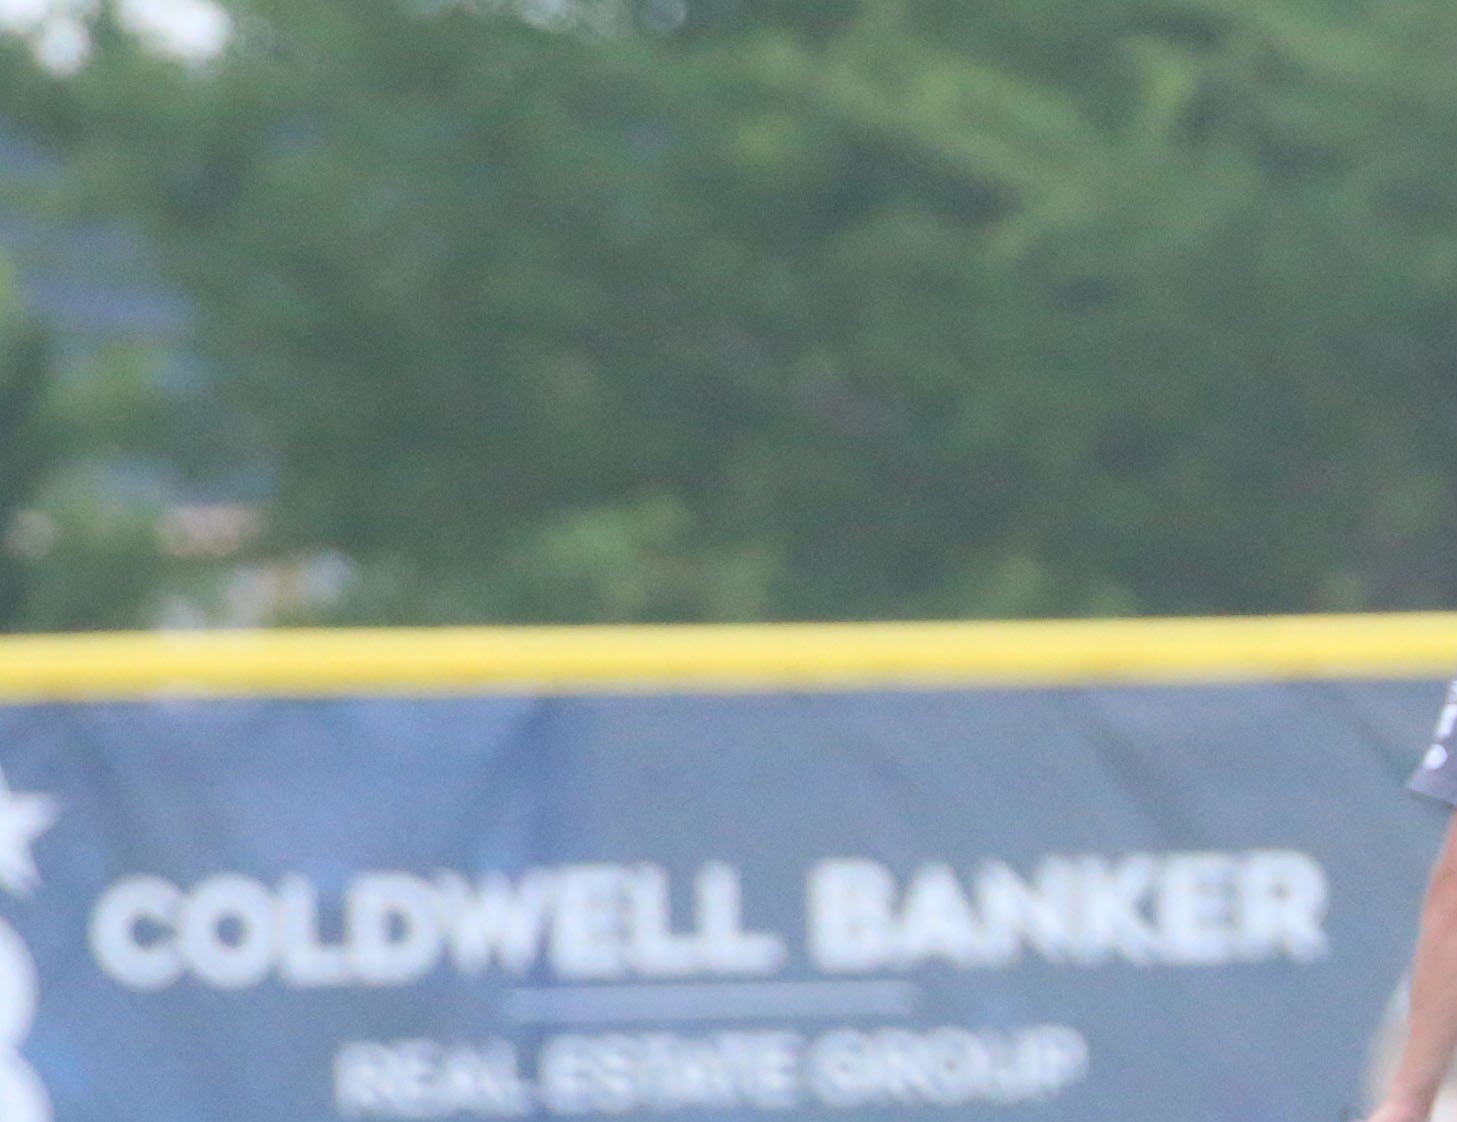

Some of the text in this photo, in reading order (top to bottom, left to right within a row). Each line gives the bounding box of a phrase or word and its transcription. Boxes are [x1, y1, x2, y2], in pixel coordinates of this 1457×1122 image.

[90, 851, 1330, 990] COLDWELL BANKER
[334, 1022, 1088, 1118] REAL ESTATE GROUP
